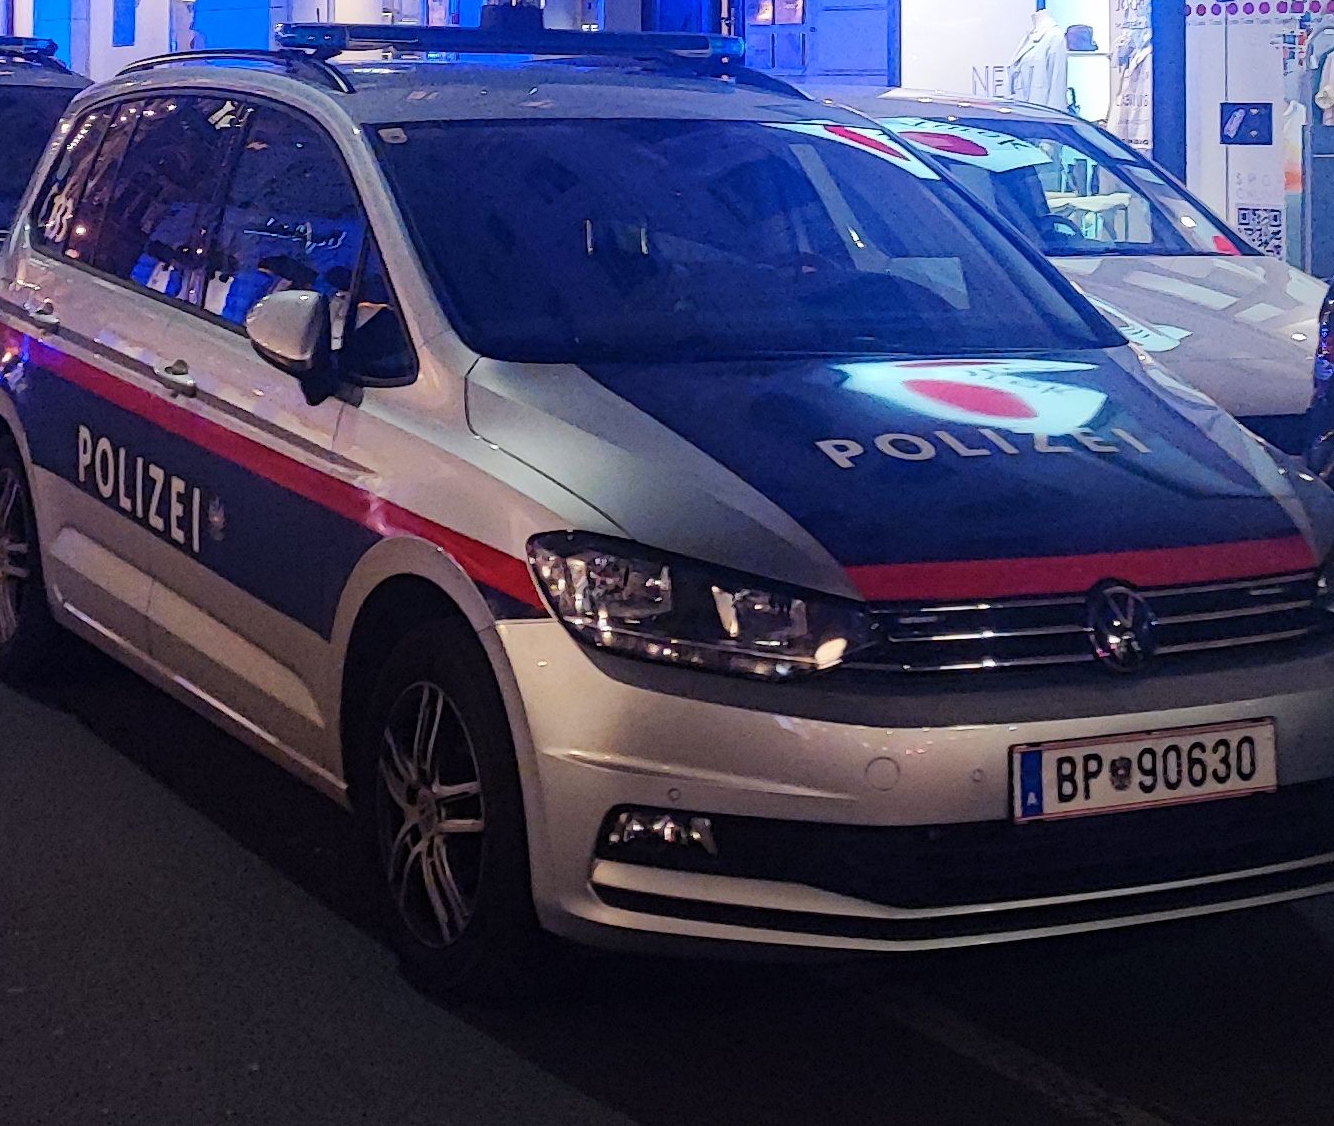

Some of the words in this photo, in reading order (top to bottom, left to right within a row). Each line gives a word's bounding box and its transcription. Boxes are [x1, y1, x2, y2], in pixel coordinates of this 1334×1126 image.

[78, 425, 200, 553] POLIZEI
[1056, 753, 1103, 803] BP
[1137, 736, 1257, 794] 90630
